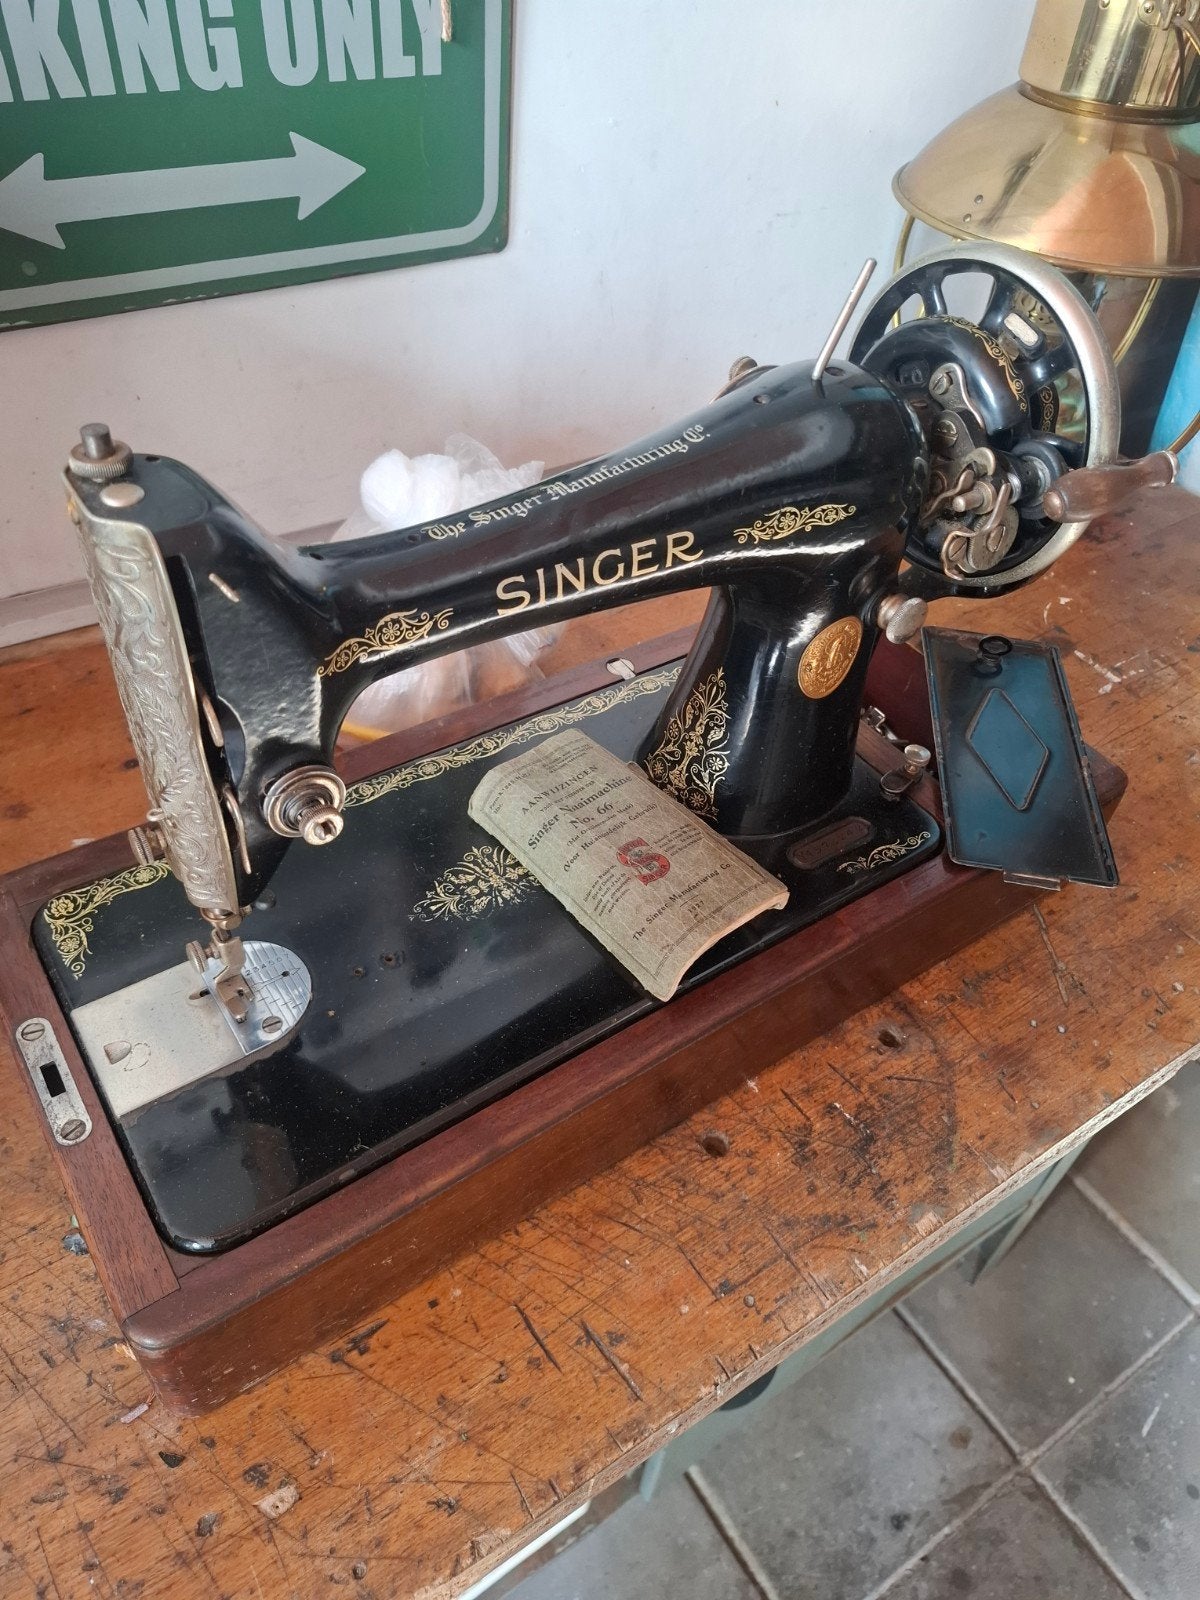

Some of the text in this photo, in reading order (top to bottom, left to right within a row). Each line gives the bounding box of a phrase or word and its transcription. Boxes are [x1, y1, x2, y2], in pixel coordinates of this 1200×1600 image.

[0, 0, 442, 102] KING ONLY
[421, 520, 466, 540] The
[468, 493, 543, 528] Singer
[540, 438, 689, 501] Manufacturing
[495, 530, 704, 616] SINGER
[528, 813, 562, 850] Singer
[559, 775, 633, 817] Naaimachine
[568, 802, 614, 830] No. 66
[632, 926, 647, 941] The
[645, 903, 669, 925] Singer
[668, 869, 720, 902] Manufacturing
